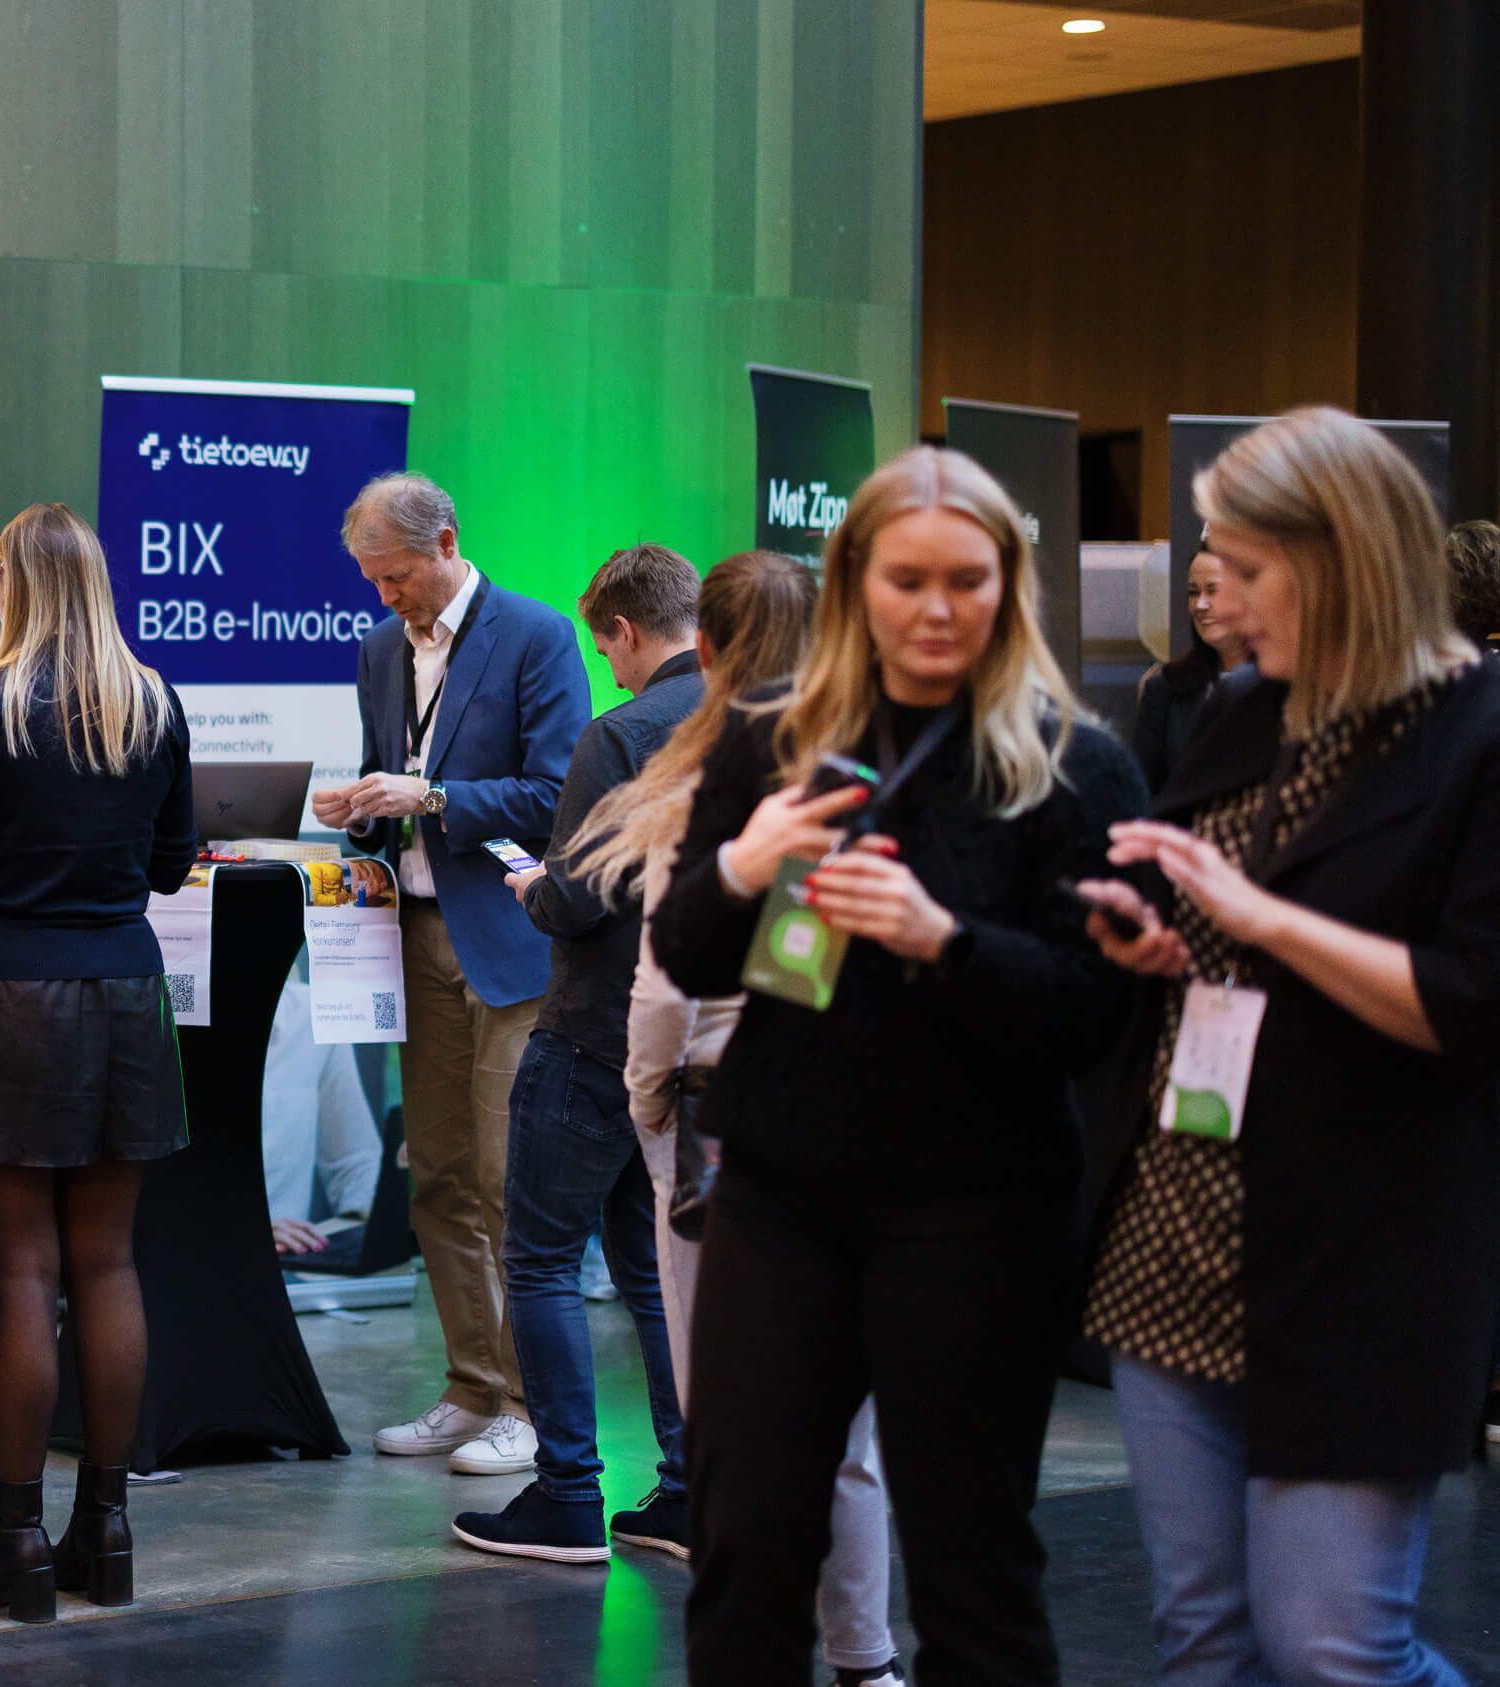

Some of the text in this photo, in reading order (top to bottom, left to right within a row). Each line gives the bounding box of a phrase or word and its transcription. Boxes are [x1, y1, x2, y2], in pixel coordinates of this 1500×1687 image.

[178, 434, 310, 477] tietoevry
[141, 521, 224, 576] BIX
[138, 600, 374, 642] B2B e-Invoice
[187, 711, 206, 728] elp
[210, 714, 235, 728] you
